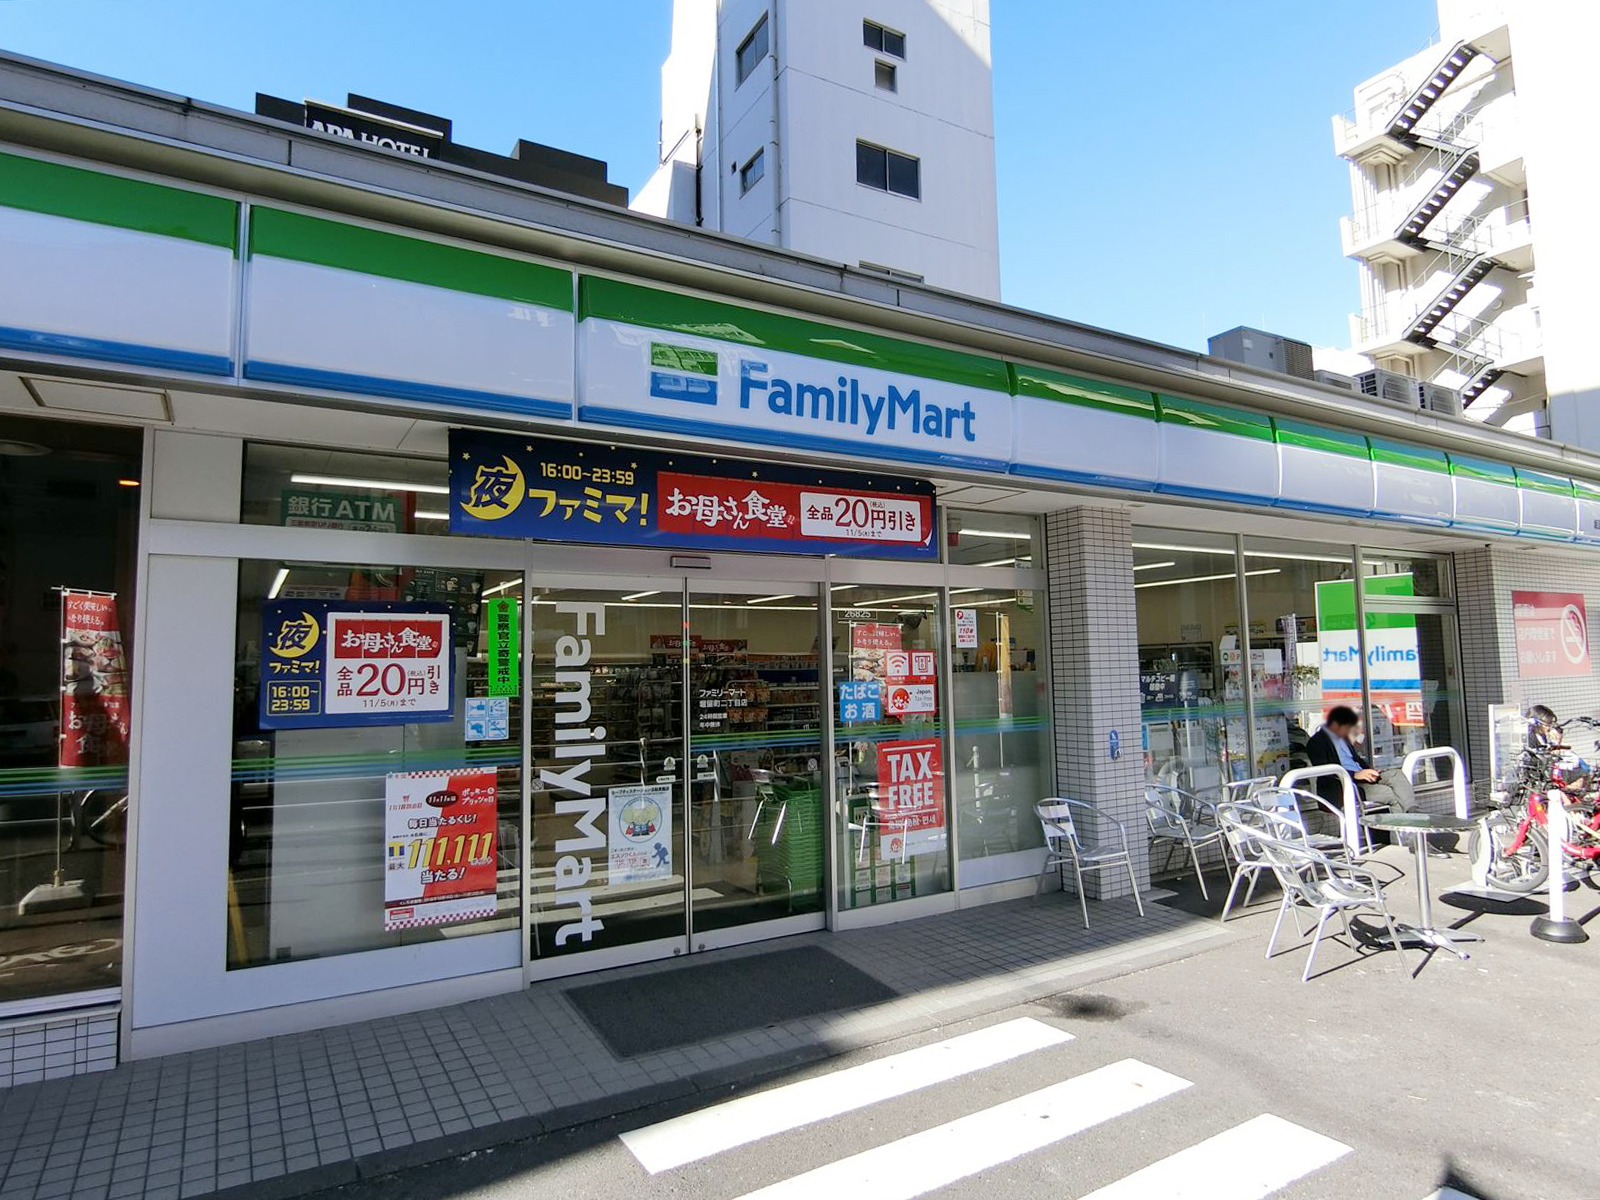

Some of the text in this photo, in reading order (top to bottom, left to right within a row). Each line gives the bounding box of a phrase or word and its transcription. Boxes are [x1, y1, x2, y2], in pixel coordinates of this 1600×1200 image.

[740, 359, 976, 442] FamilyMart
[528, 486, 649, 527] ファミマ!
[665, 487, 788, 530] お母さん食堂
[341, 627, 433, 654] お母さん食堂
[269, 660, 321, 674] ファミマ!
[271, 698, 310, 712] 23:59
[699, 688, 747, 698] ファミリーマート
[839, 684, 879, 700] たばこ
[845, 703, 876, 719] お酒
[540, 602, 606, 947] FamilyMart
[887, 751, 933, 783] TAX
[888, 781, 934, 810] FREE
[421, 866, 466, 885] 当たる!
